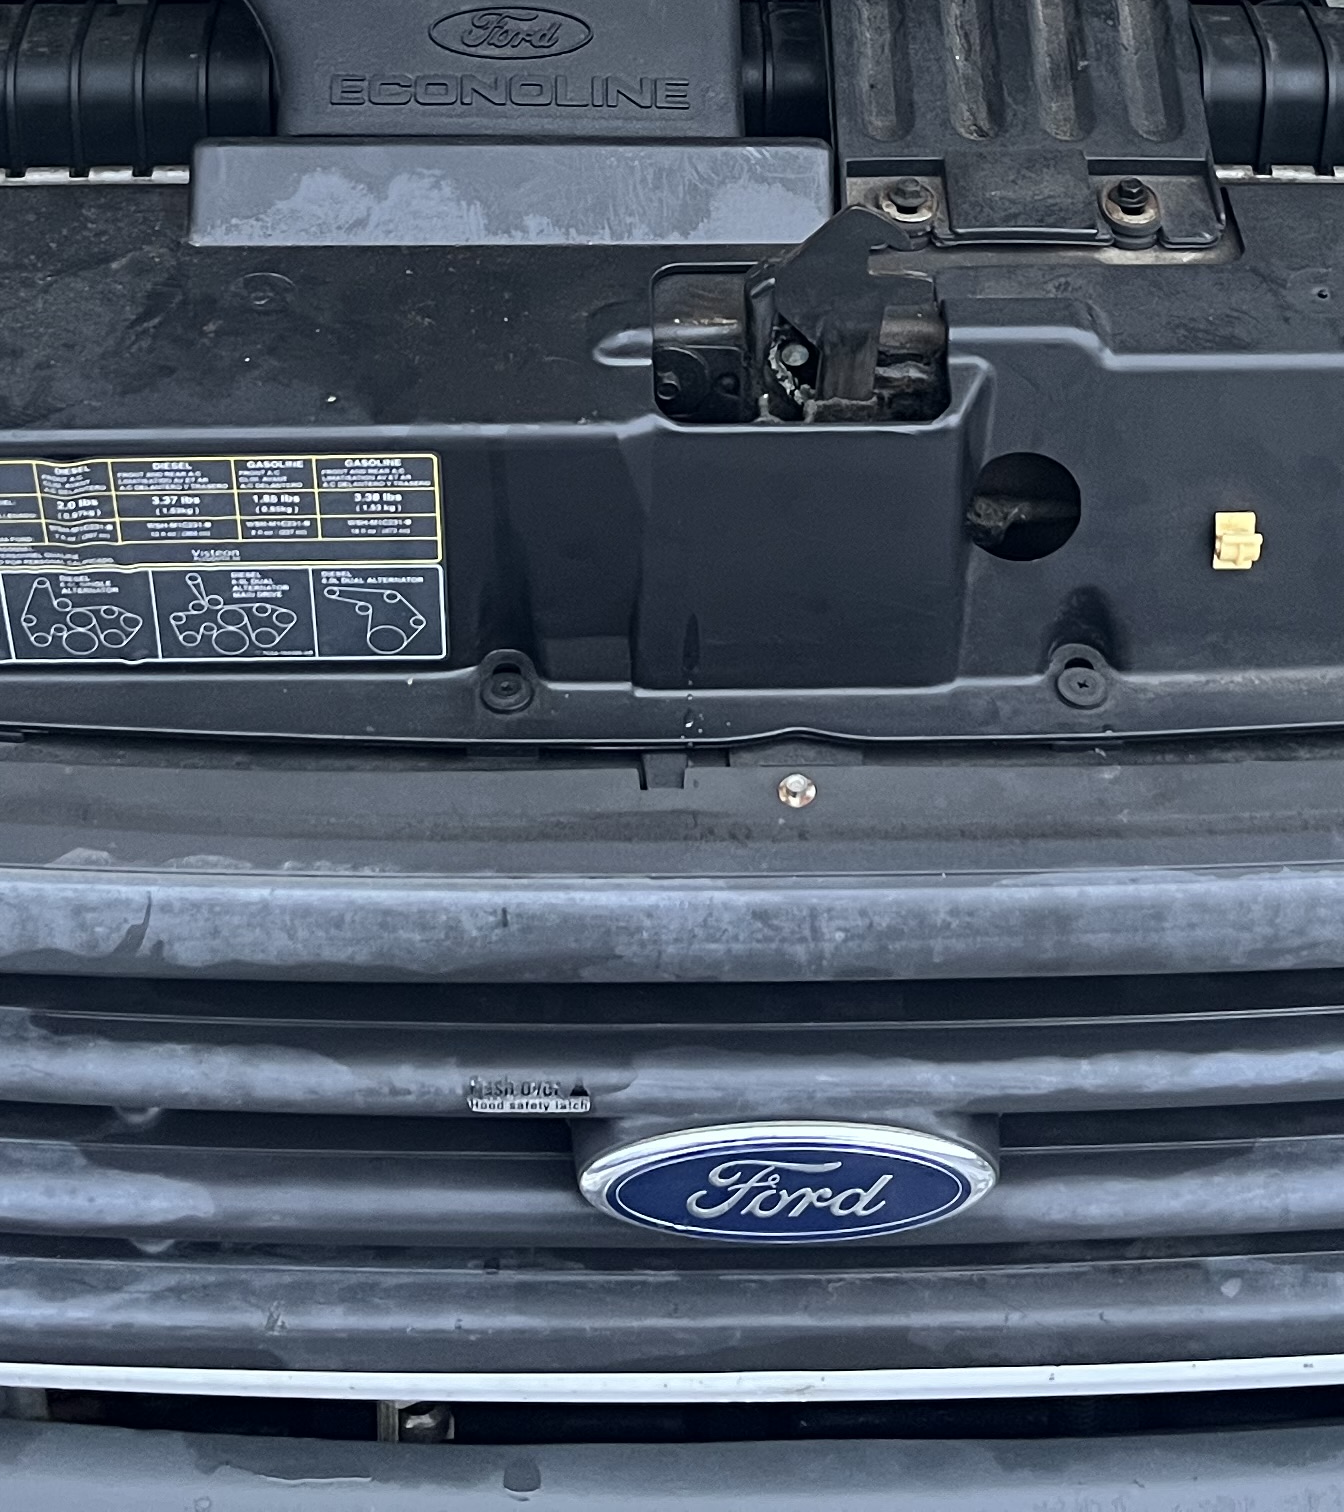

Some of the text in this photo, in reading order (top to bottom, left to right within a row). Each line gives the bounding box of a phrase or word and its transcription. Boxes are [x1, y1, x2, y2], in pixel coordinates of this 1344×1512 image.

[460, 12, 562, 49] Ford
[329, 73, 691, 110] ECONOLINE
[181, 496, 201, 505] lbs
[280, 494, 300, 503] lbs
[383, 492, 402, 501] lbs
[78, 499, 98, 507] lbs
[474, 1100, 588, 1111] Hood safety latch
[685, 1159, 893, 1219] Ford
